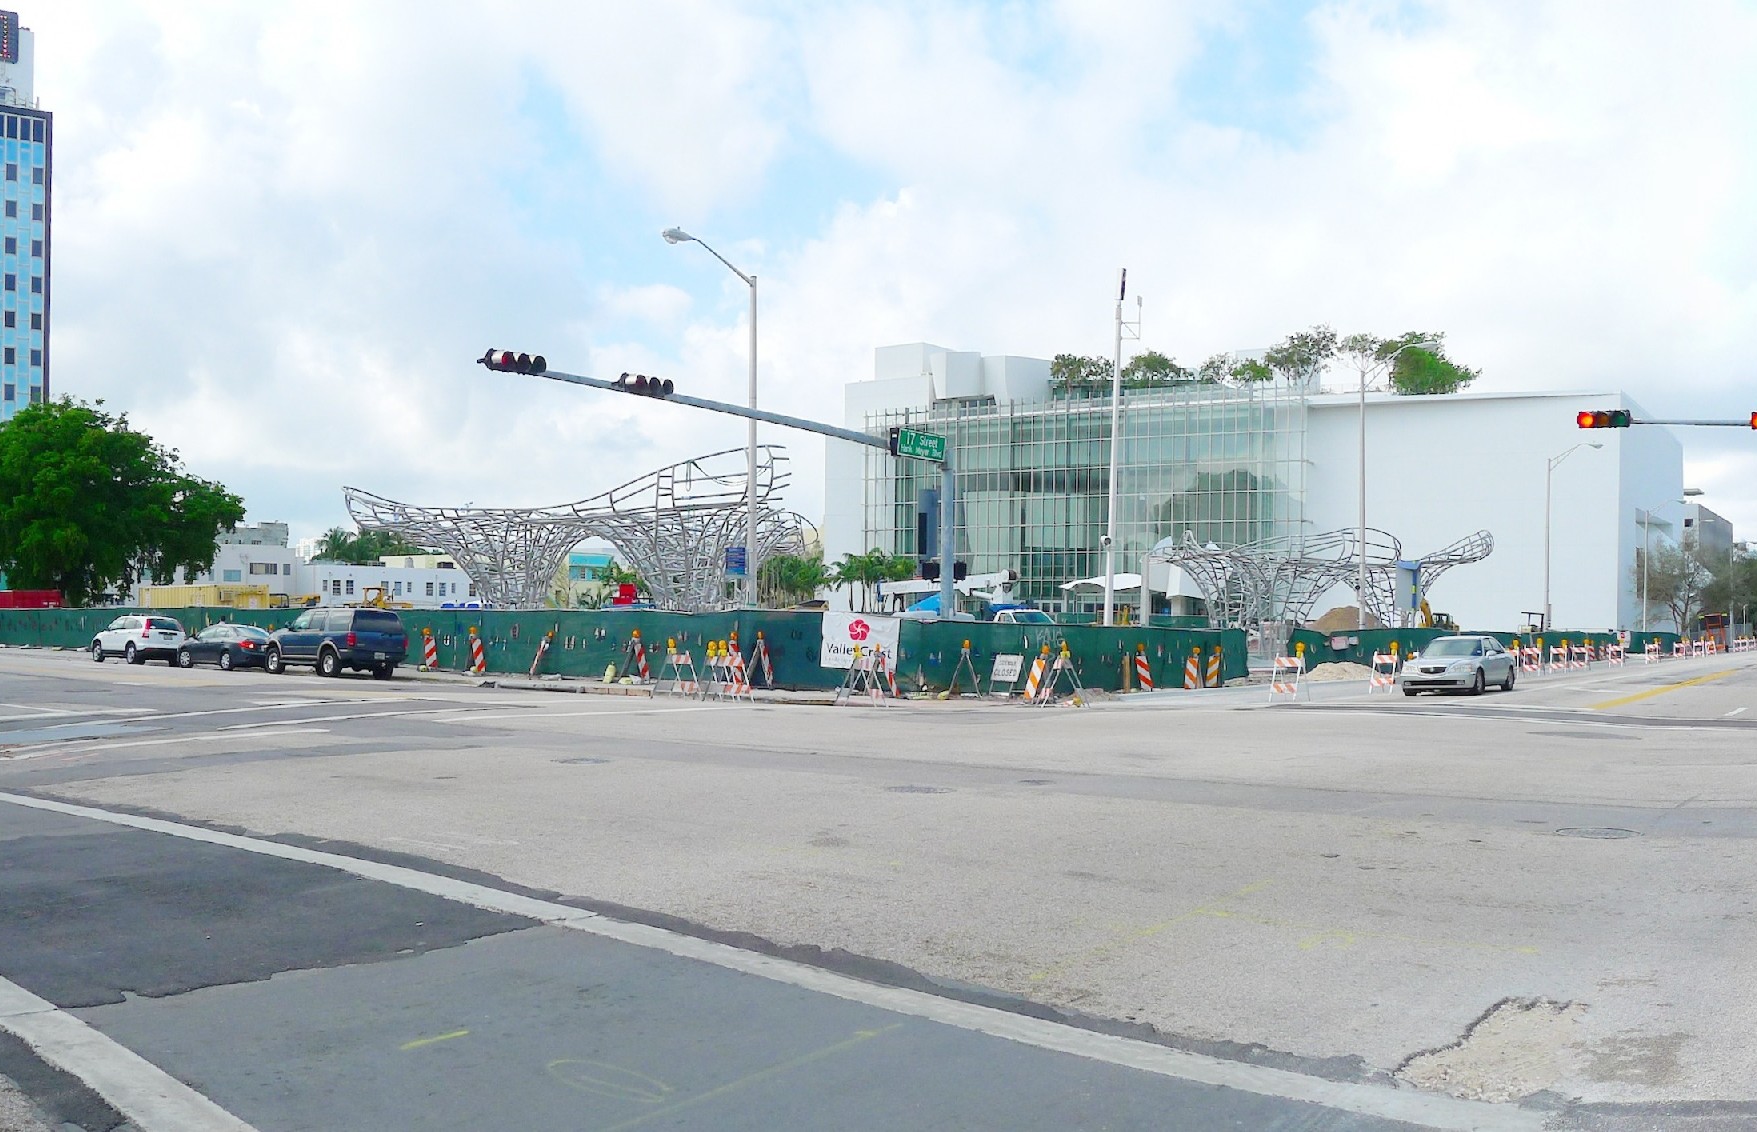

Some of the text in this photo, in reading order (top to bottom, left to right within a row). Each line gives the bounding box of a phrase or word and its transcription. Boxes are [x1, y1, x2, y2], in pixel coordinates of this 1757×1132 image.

[906, 431, 938, 449] 17 Street
[826, 643, 893, 660] ValleCrst
[994, 668, 1018, 677] CLOSED
